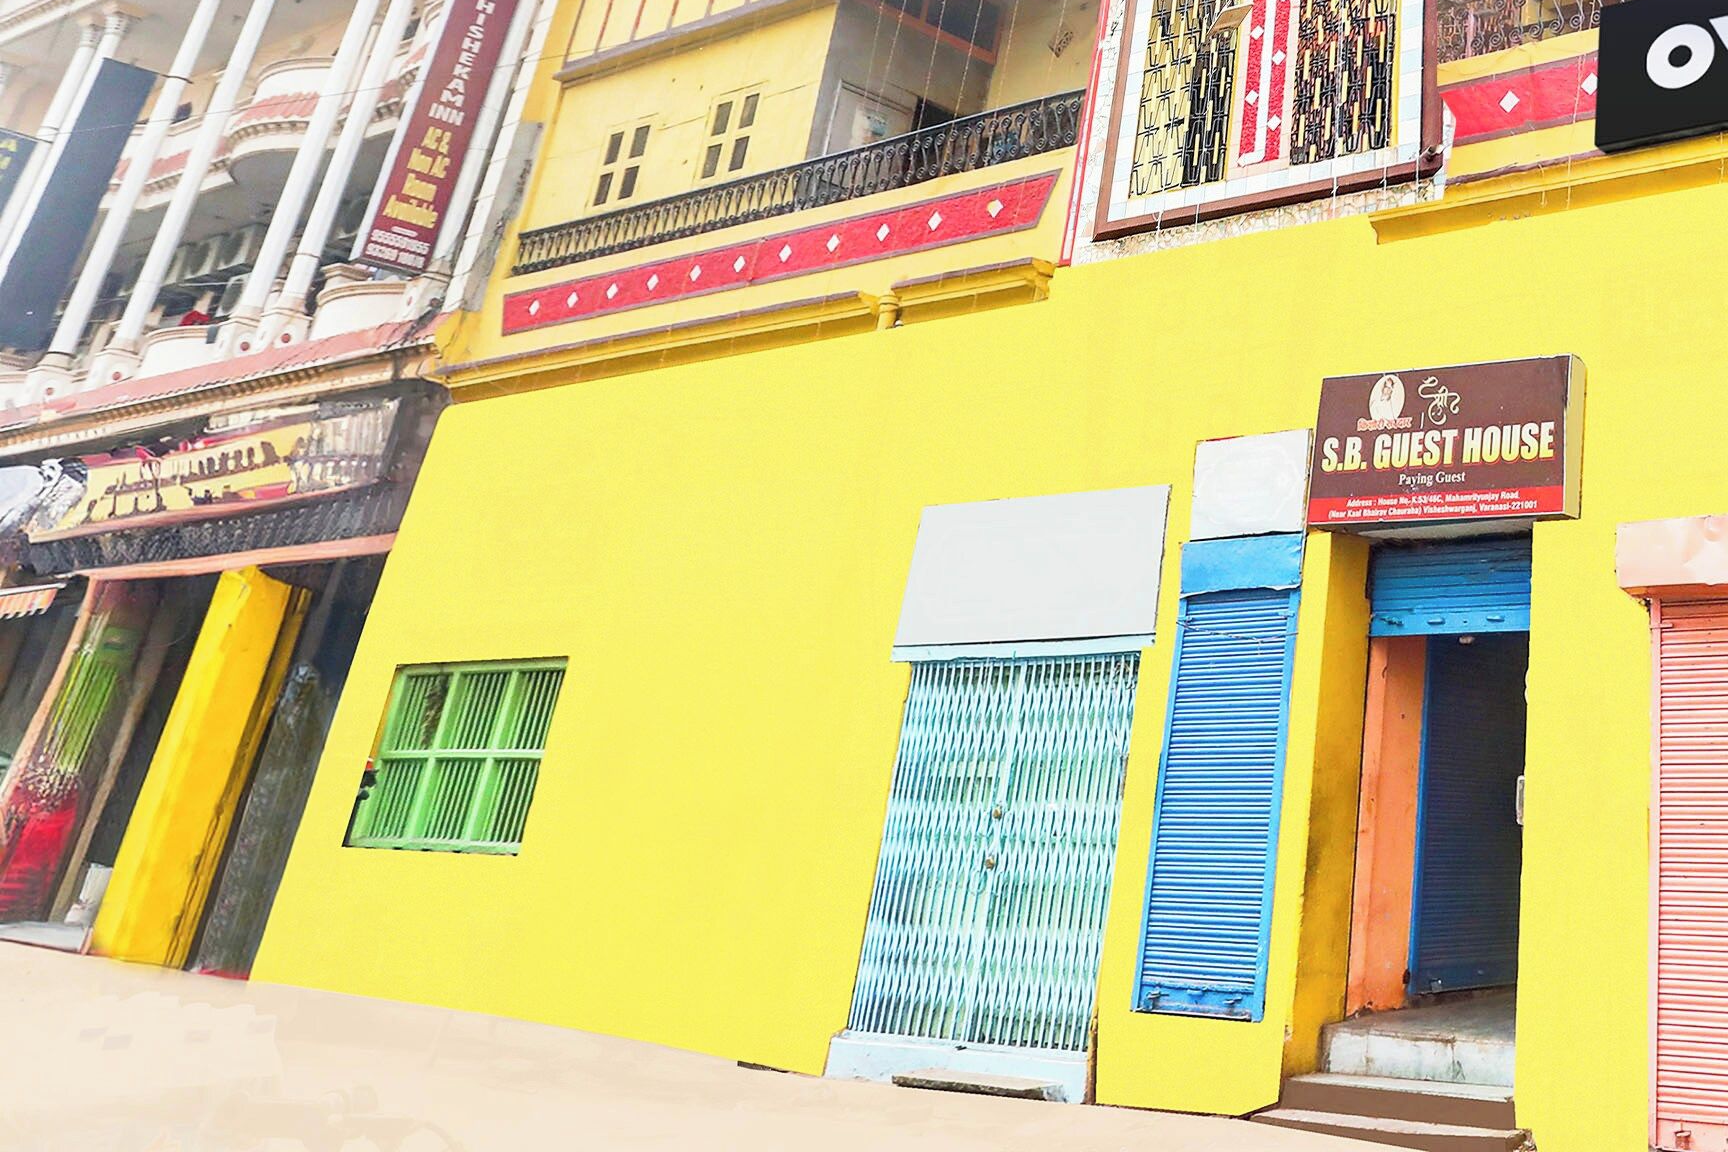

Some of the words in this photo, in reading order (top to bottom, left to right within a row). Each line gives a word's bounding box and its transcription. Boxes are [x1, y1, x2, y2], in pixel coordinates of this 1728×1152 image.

[428, 103, 465, 126] INN
[1321, 436, 1367, 472] S.B.
[1373, 429, 1459, 469] GUEST
[1462, 421, 1555, 463] HOUSE
[1398, 473, 1433, 487] Paying
[1435, 471, 1466, 484] Guest
